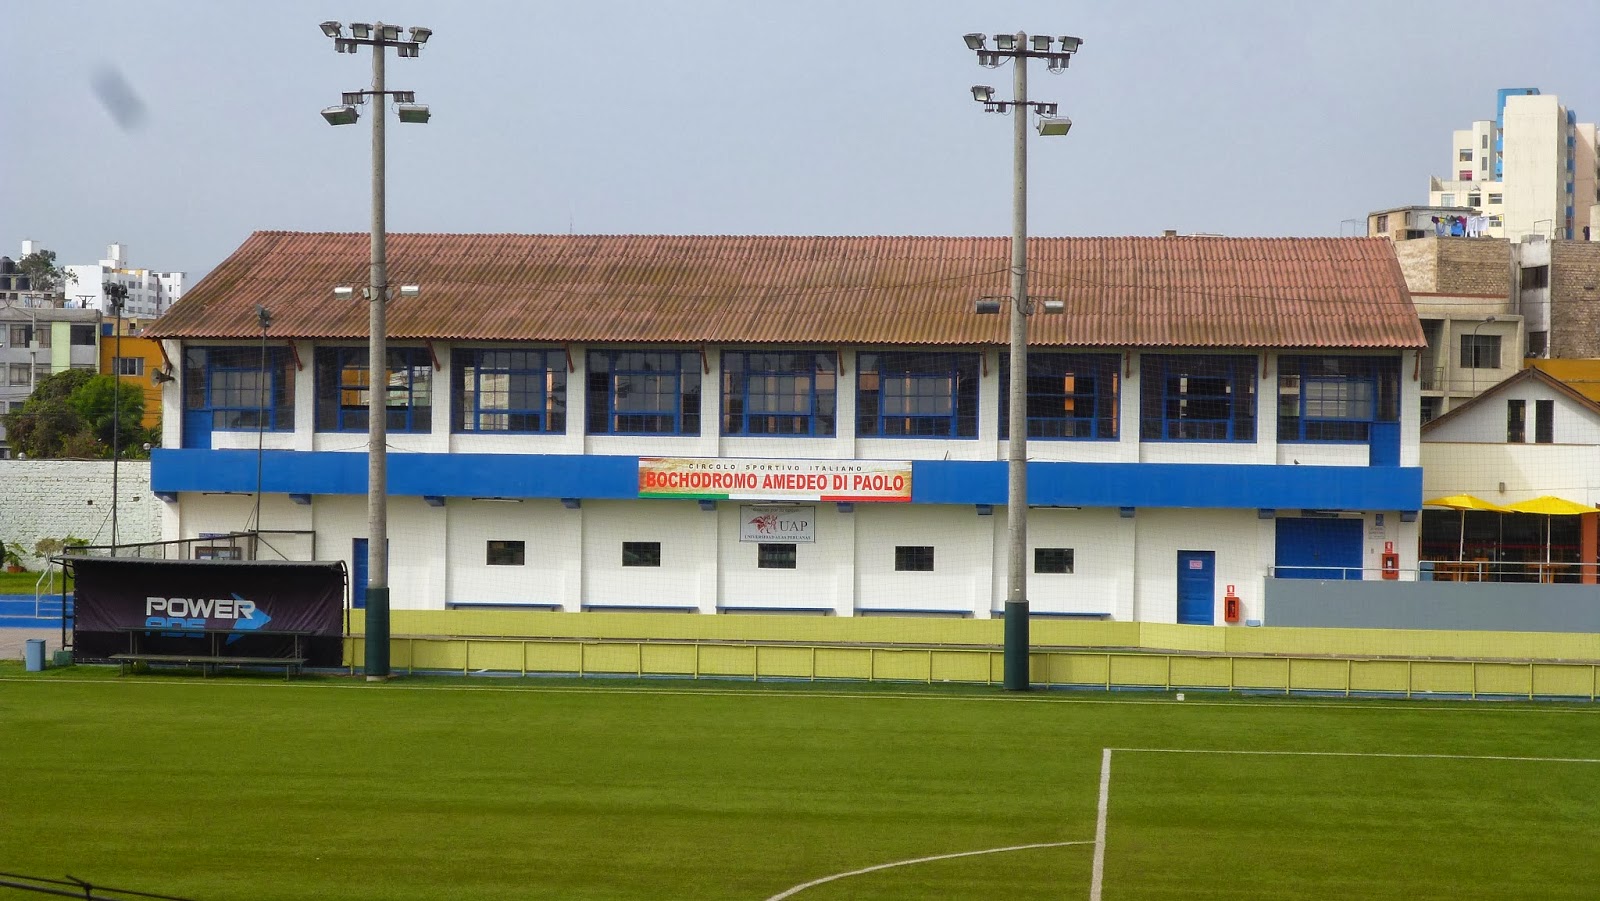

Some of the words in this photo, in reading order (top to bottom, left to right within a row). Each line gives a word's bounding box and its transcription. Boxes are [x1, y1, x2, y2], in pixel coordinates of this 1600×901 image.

[646, 471, 758, 488] BOCHODROMO
[762, 474, 828, 489] AMEDEO
[832, 475, 848, 490] DI
[853, 475, 904, 490] PAOLO
[779, 520, 808, 532] UAP
[146, 597, 256, 619] POWER
